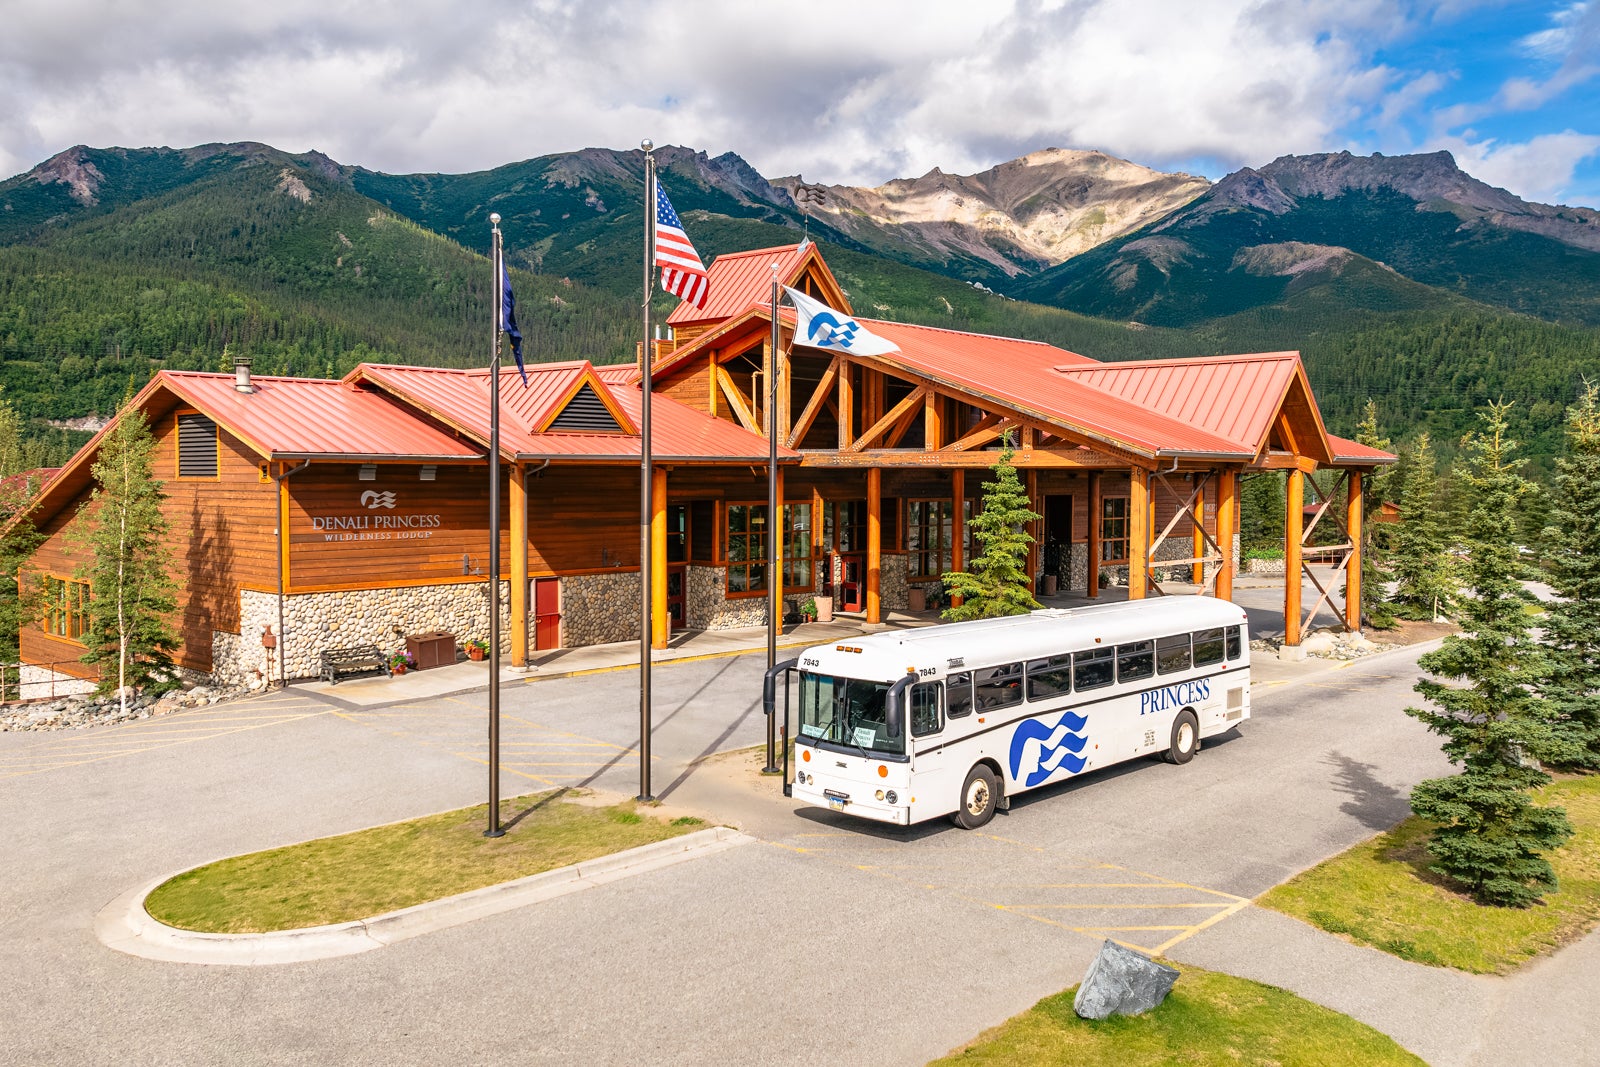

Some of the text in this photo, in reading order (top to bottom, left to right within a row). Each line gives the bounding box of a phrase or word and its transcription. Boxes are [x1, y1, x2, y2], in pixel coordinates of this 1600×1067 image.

[313, 514, 441, 530] DENALI PRINCESS
[325, 531, 431, 541] WILDERNESS LODGE
[803, 658, 819, 667] 7843
[919, 667, 937, 677] 7843
[1140, 678, 1210, 715] PRINCESS
